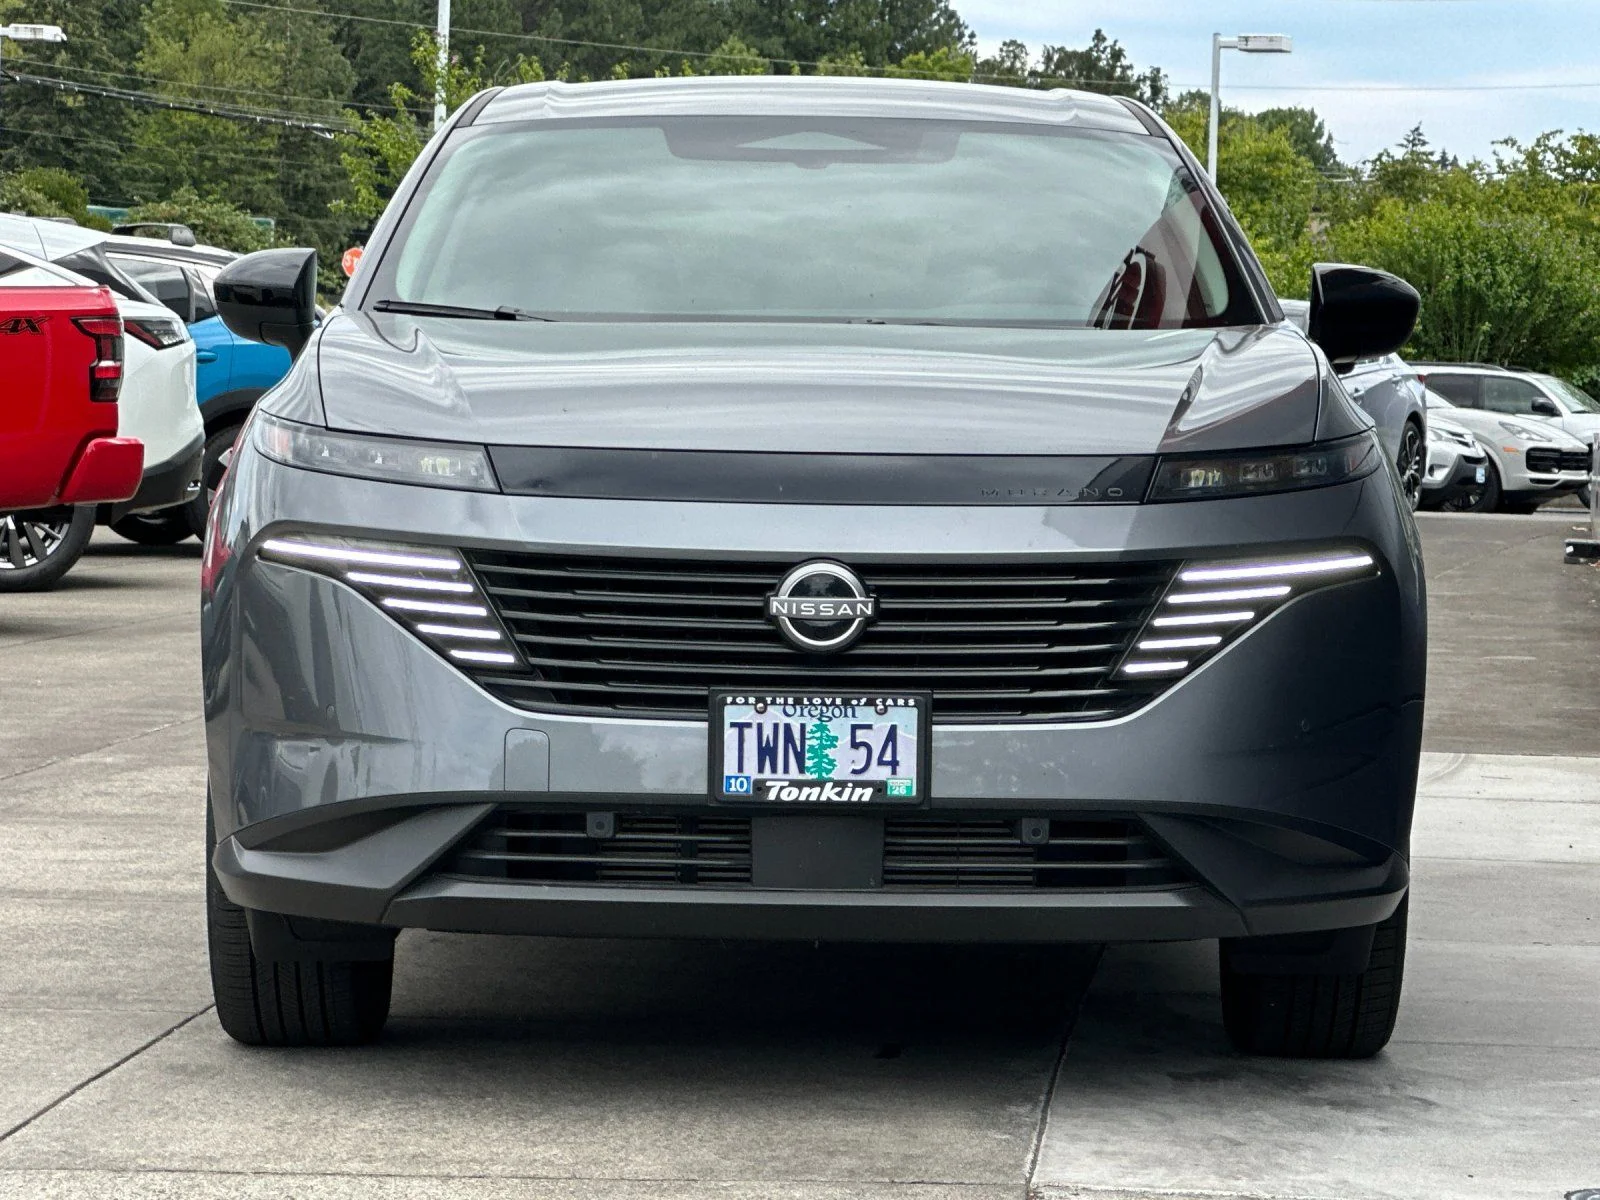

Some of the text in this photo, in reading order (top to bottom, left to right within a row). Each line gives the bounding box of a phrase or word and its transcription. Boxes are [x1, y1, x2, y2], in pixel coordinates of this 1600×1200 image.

[772, 601, 873, 615] NISSAN
[726, 696, 756, 705] FOR
[765, 697, 794, 705] THE
[803, 697, 843, 705] LOVE
[876, 698, 916, 706] CARS
[782, 704, 858, 723] Oregon
[729, 721, 900, 776] TWN 54
[728, 778, 748, 793] 10
[764, 780, 874, 802] Tonkin
[890, 785, 907, 796] 26
